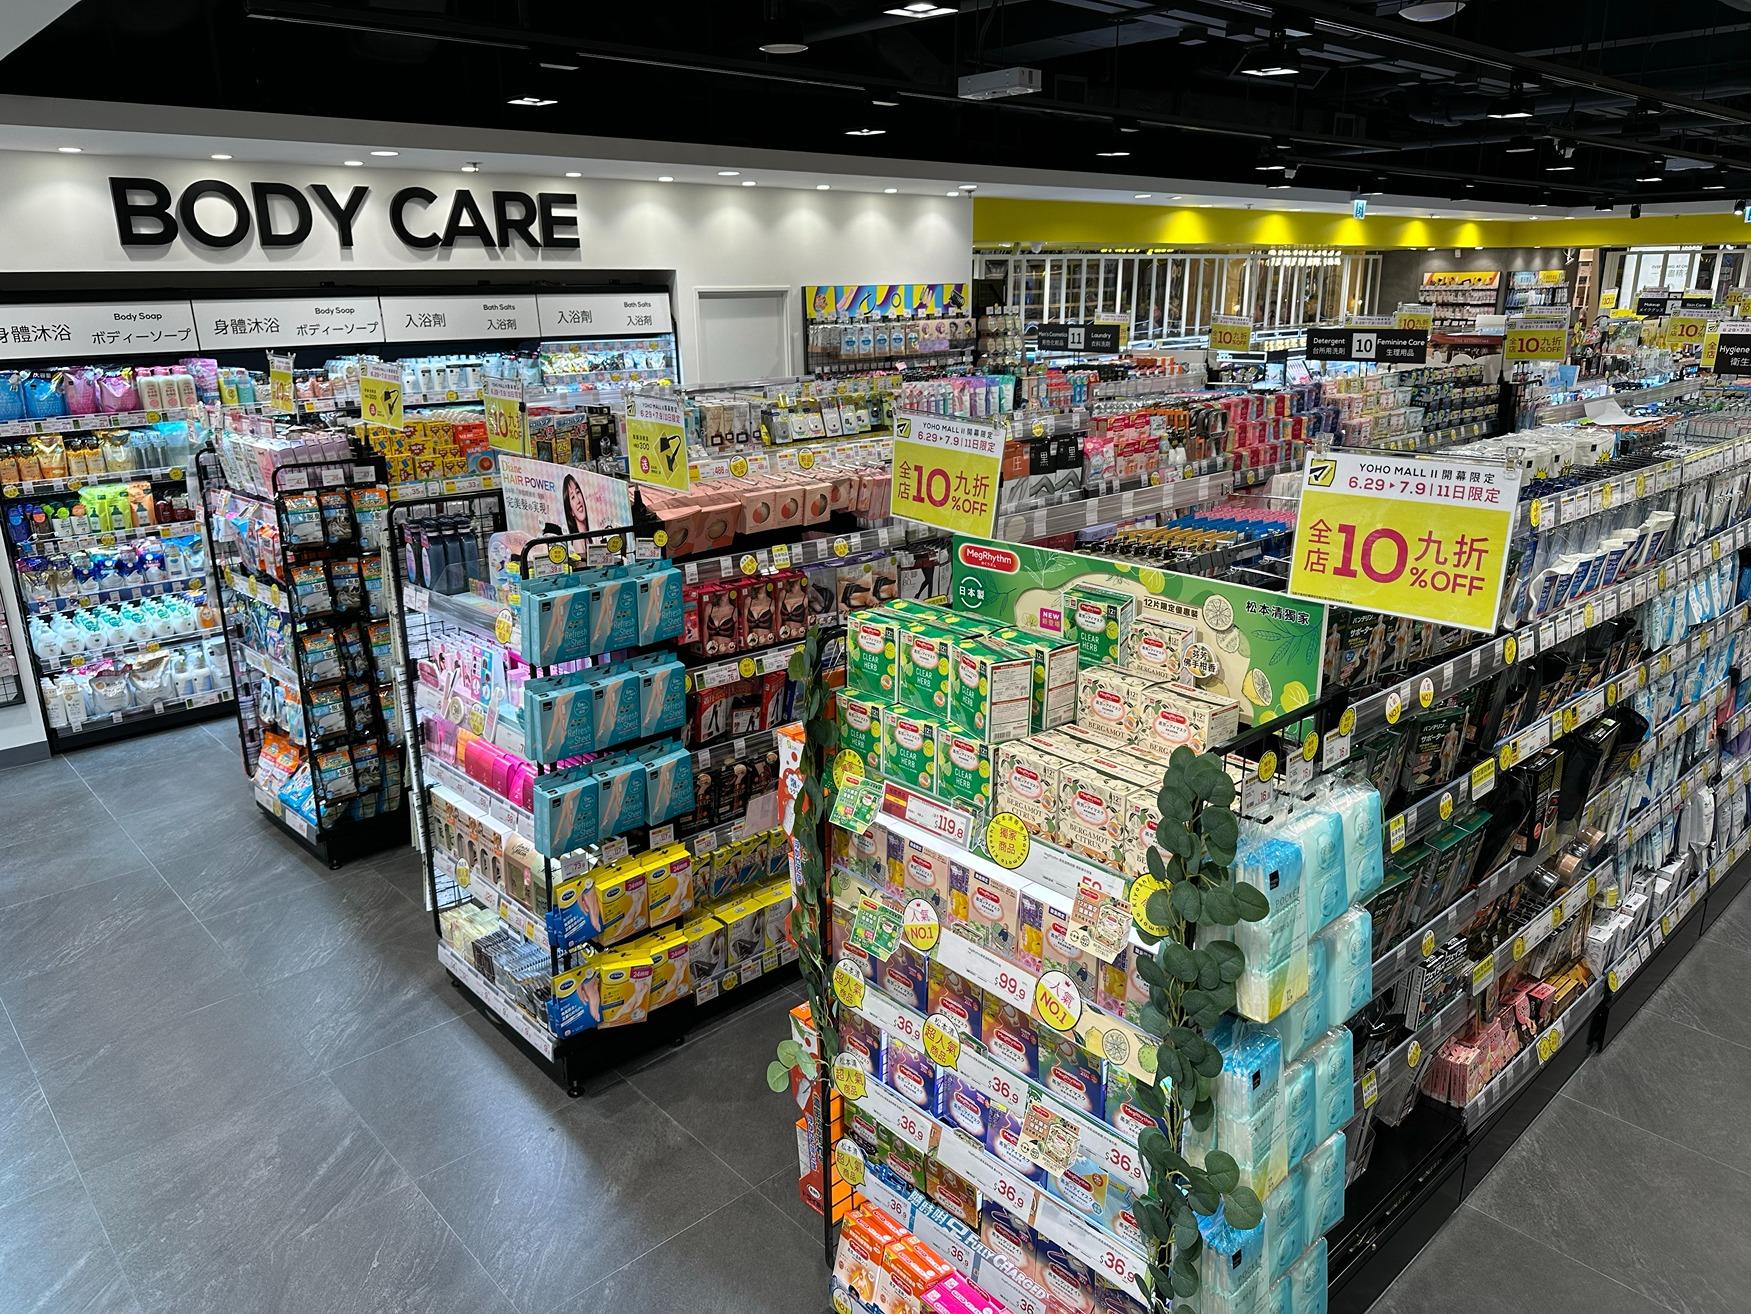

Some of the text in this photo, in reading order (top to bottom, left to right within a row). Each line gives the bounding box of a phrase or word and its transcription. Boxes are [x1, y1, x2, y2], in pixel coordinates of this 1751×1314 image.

[109, 177, 580, 248] BODY CARE
[315, 307, 355, 316] Body Soap
[483, 303, 515, 311] Bath Salts
[114, 312, 162, 322] Body Soap
[405, 313, 447, 329] 入浴劑
[557, 310, 593, 324] 入浴劑
[214, 317, 280, 335] 身體沐浴
[297, 321, 379, 337] ボディーソープ
[1678, 324, 1698, 337] 10
[0, 324, 72, 344] 身體沐浴
[92, 328, 191, 346] ボディーソープ
[1071, 333, 1082, 345] 11
[1219, 331, 1232, 345] 10
[1313, 337, 1345, 346] Detergent
[1541, 336, 1561, 347] 九折
[1355, 338, 1372, 353] 10
[1377, 339, 1407, 347] Feminine
[1517, 338, 1540, 353] 10
[1707, 342, 1715, 358] 全店
[1720, 345, 1750, 355] Hygiene
[1386, 349, 1414, 358] 生理用品
[918, 431, 937, 443] 6.29
[923, 421, 994, 440] YOHO MALL 開幕限定
[501, 461, 521, 473] Diane
[1359, 463, 1391, 475] YOHO
[1394, 466, 1426, 478] MALL
[1442, 469, 1495, 486] 開幕限定
[502, 473, 524, 487] HAIR
[524, 477, 556, 493] POWER
[897, 460, 911, 500] 全店
[912, 465, 950, 508] 10
[955, 470, 990, 499] 九折
[1348, 476, 1501, 504] 6.29 7.9 11日限定
[951, 496, 988, 517] %OFF
[1304, 518, 1333, 575] 全店
[1332, 523, 1409, 584] 10
[1413, 530, 1489, 572] 九折
[966, 548, 1012, 566] MegRhythm
[1409, 566, 1486, 598] %OFF
[959, 585, 985, 600] 日本製
[1043, 611, 1059, 620] NEW
[1246, 600, 1310, 626] 松本清獨家
[565, 628, 587, 639] Refresh
[1080, 632, 1100, 645] CLEAR
[1350, 627, 1373, 637] サポーター
[571, 638, 587, 647] Sheet
[1082, 642, 1098, 652] HERB
[863, 652, 879, 664] CLEAR
[1192, 650, 1208, 660] 芬芳
[863, 660, 878, 671] HERB
[1137, 664, 1169, 679] BERGAMOT
[1183, 659, 1217, 673] 佛手柑香
[916, 668, 932, 679] CLEAR
[917, 676, 931, 687] HERB
[962, 685, 975, 698] CLEAR
[962, 695, 974, 707] HERB
[568, 726, 591, 738] Refresh
[851, 730, 867, 741] CLEAR
[1088, 721, 1125, 739] BERGAMOT
[1421, 733, 1445, 742] サポーター
[575, 735, 591, 745] Sheet
[851, 739, 866, 749] HERB
[900, 749, 917, 760] CLEAR
[901, 757, 916, 769] HERB
[954, 768, 971, 780] CLEAR
[955, 778, 970, 789] HERB
[1007, 797, 1043, 818] BERGAMOT
[1011, 807, 1036, 822] CITRUS
[934, 814, 963, 839] $119.8
[1000, 827, 1017, 841] 獨家
[1070, 823, 1109, 846] BERGAMOT
[1075, 833, 1101, 851] CITRUS
[998, 840, 1016, 854] 商品
[1275, 886, 1300, 909] POCKET
[911, 909, 930, 923] 人氣
[911, 925, 934, 940] NO.1
[834, 971, 862, 998] 超人氣
[994, 973, 1026, 999] $99.9
[840, 988, 854, 1004] 商品
[1050, 982, 1074, 1008] 人氣
[1040, 991, 1067, 1025] NO.1
[893, 1016, 920, 1040] $36.9
[934, 1018, 955, 1036] 松本清
[925, 1025, 958, 1056] 超人氣
[930, 1048, 947, 1063] 商品
[836, 1067, 864, 1086] 超人氣
[899, 1064, 924, 1086] MegRhythm
[1054, 1068, 1085, 1091] MegRhythm
[843, 1085, 858, 1097] 商品
[988, 1077, 1019, 1104] $36.9
[955, 1094, 979, 1115] MegRhythm
[897, 1115, 923, 1142] $36.9
[837, 1152, 863, 1175] 超人氣
[1105, 1149, 1142, 1178] $36.9
[844, 1168, 857, 1182] 商品
[993, 1180, 1024, 1208] $36.9
[964, 1234, 1046, 1299] FULLY CHARGED
[1100, 1252, 1135, 1283] $36.9
